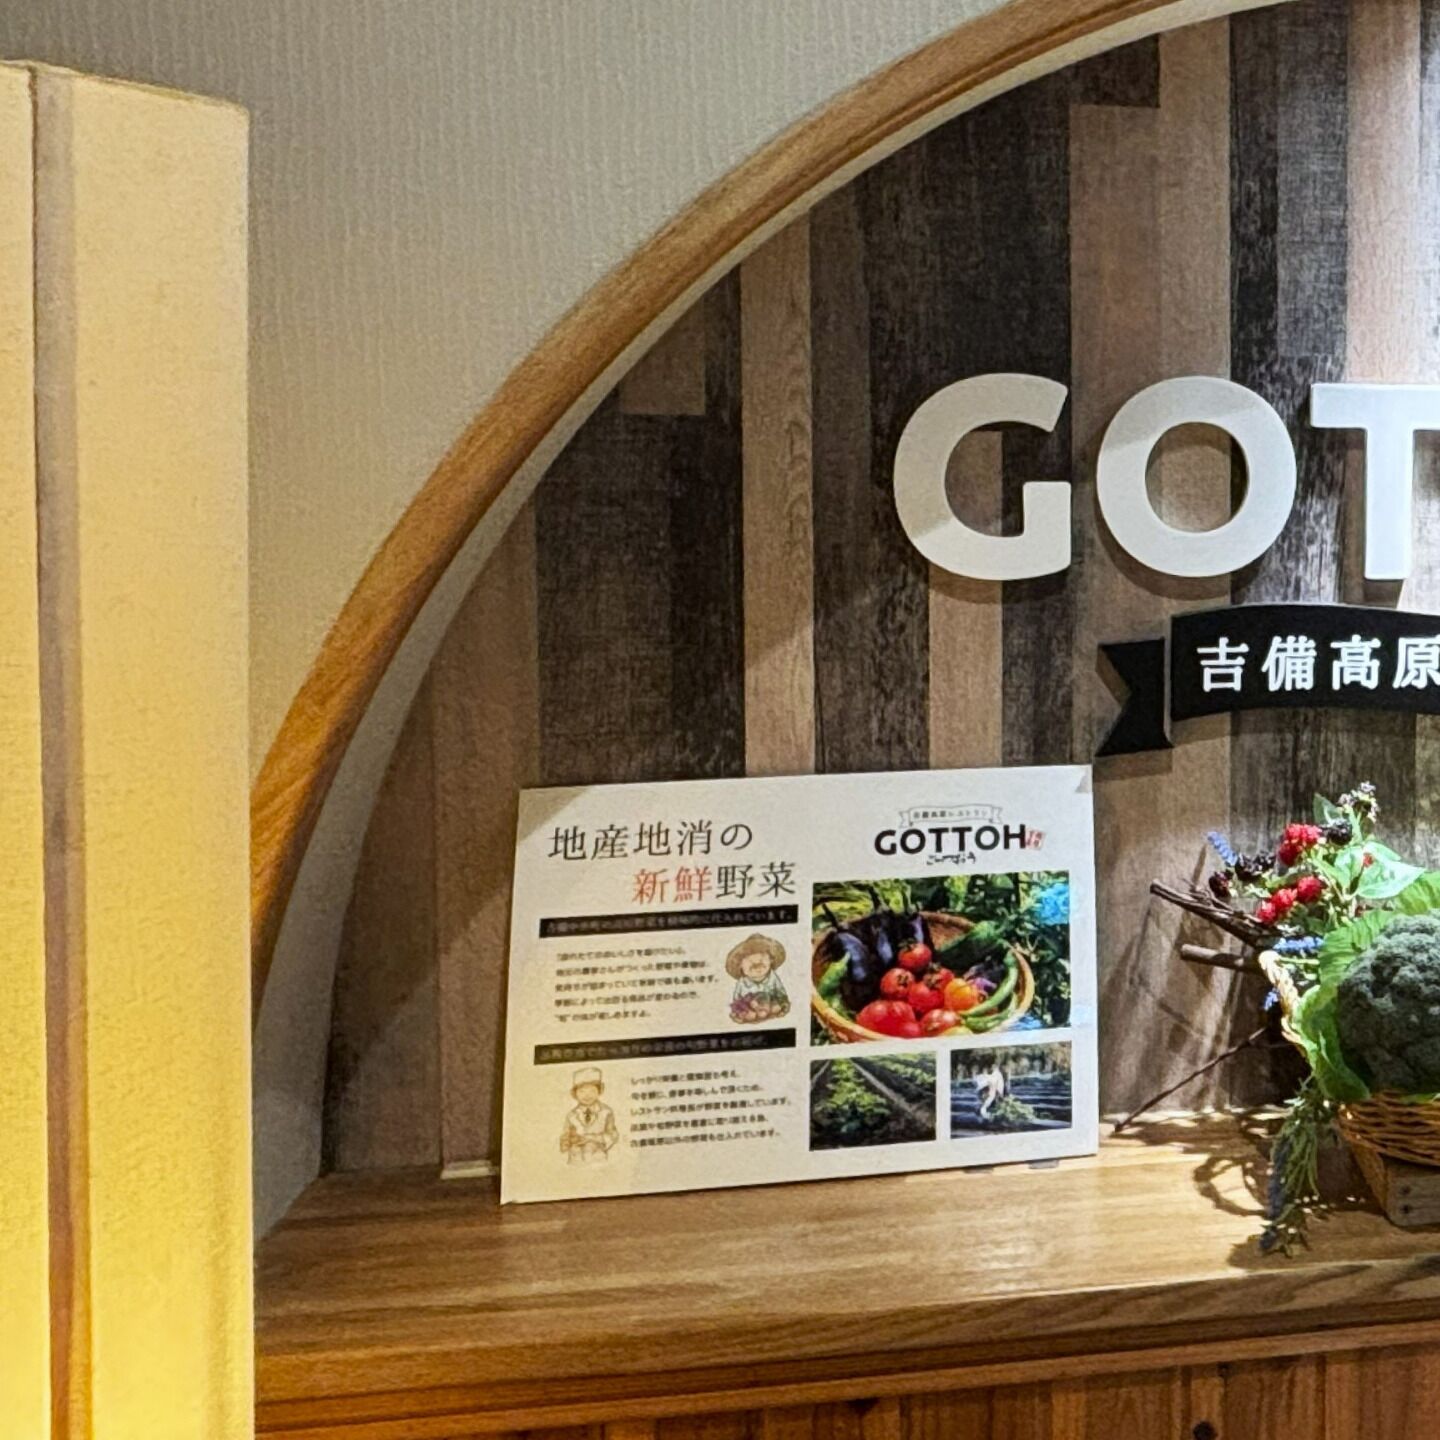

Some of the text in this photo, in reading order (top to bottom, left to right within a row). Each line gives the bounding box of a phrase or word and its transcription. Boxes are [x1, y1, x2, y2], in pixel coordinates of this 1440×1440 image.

[547, 819, 753, 861] 地産地消の
[874, 824, 1026, 856] GOTTOH
[632, 860, 797, 905] 新鮮野菜
